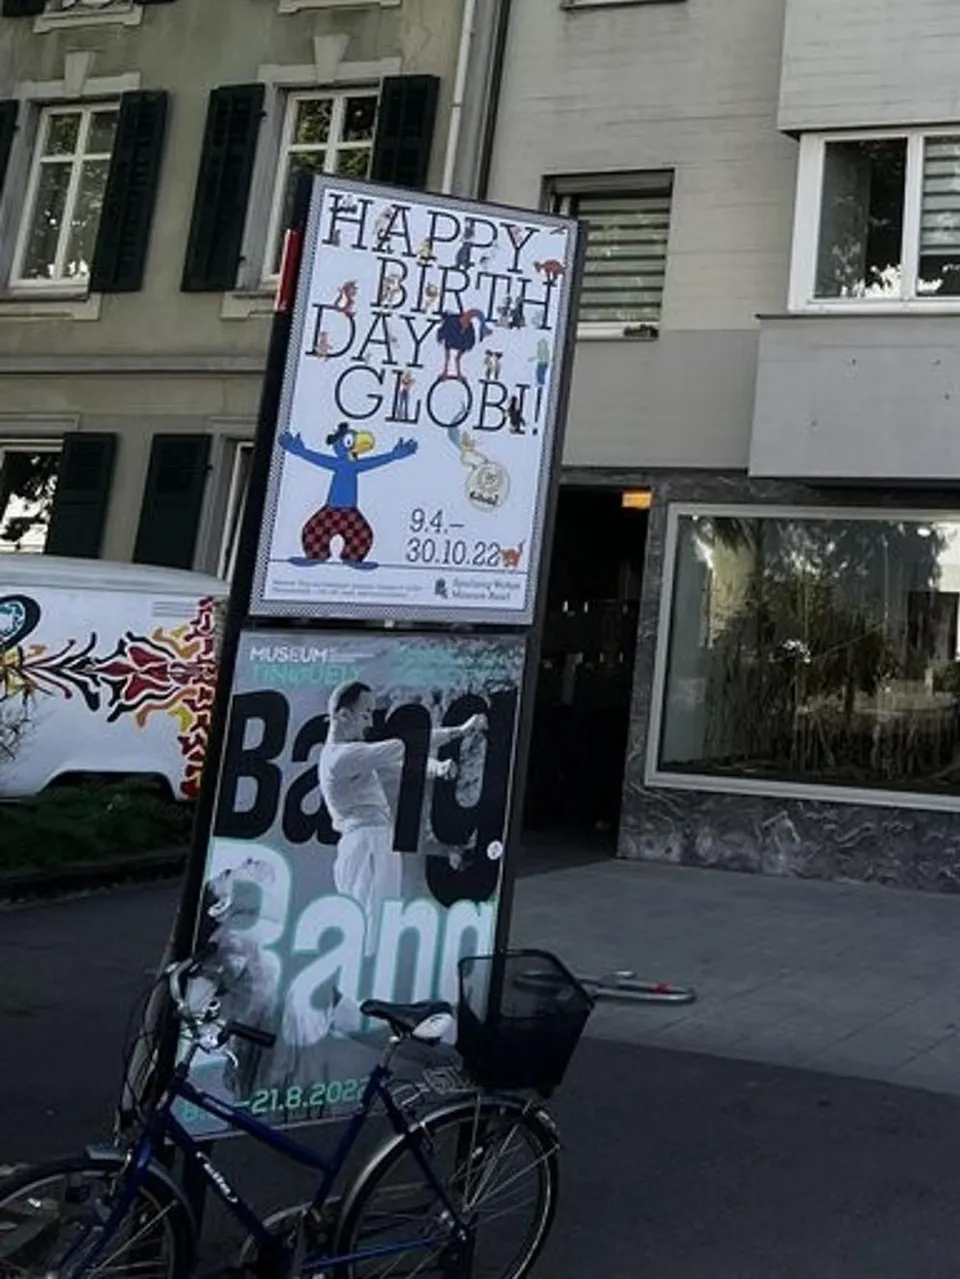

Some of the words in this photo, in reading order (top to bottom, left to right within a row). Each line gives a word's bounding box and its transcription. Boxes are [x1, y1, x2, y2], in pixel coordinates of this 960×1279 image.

[322, 193, 540, 273] HAPPY
[370, 257, 556, 331] BIRTH
[305, 303, 442, 368] DAY
[335, 365, 542, 435] GLOBI!
[406, 537, 500, 566] 30.10.22
[250, 646, 329, 663] MUSEUM
[212, 689, 519, 908] Bang
